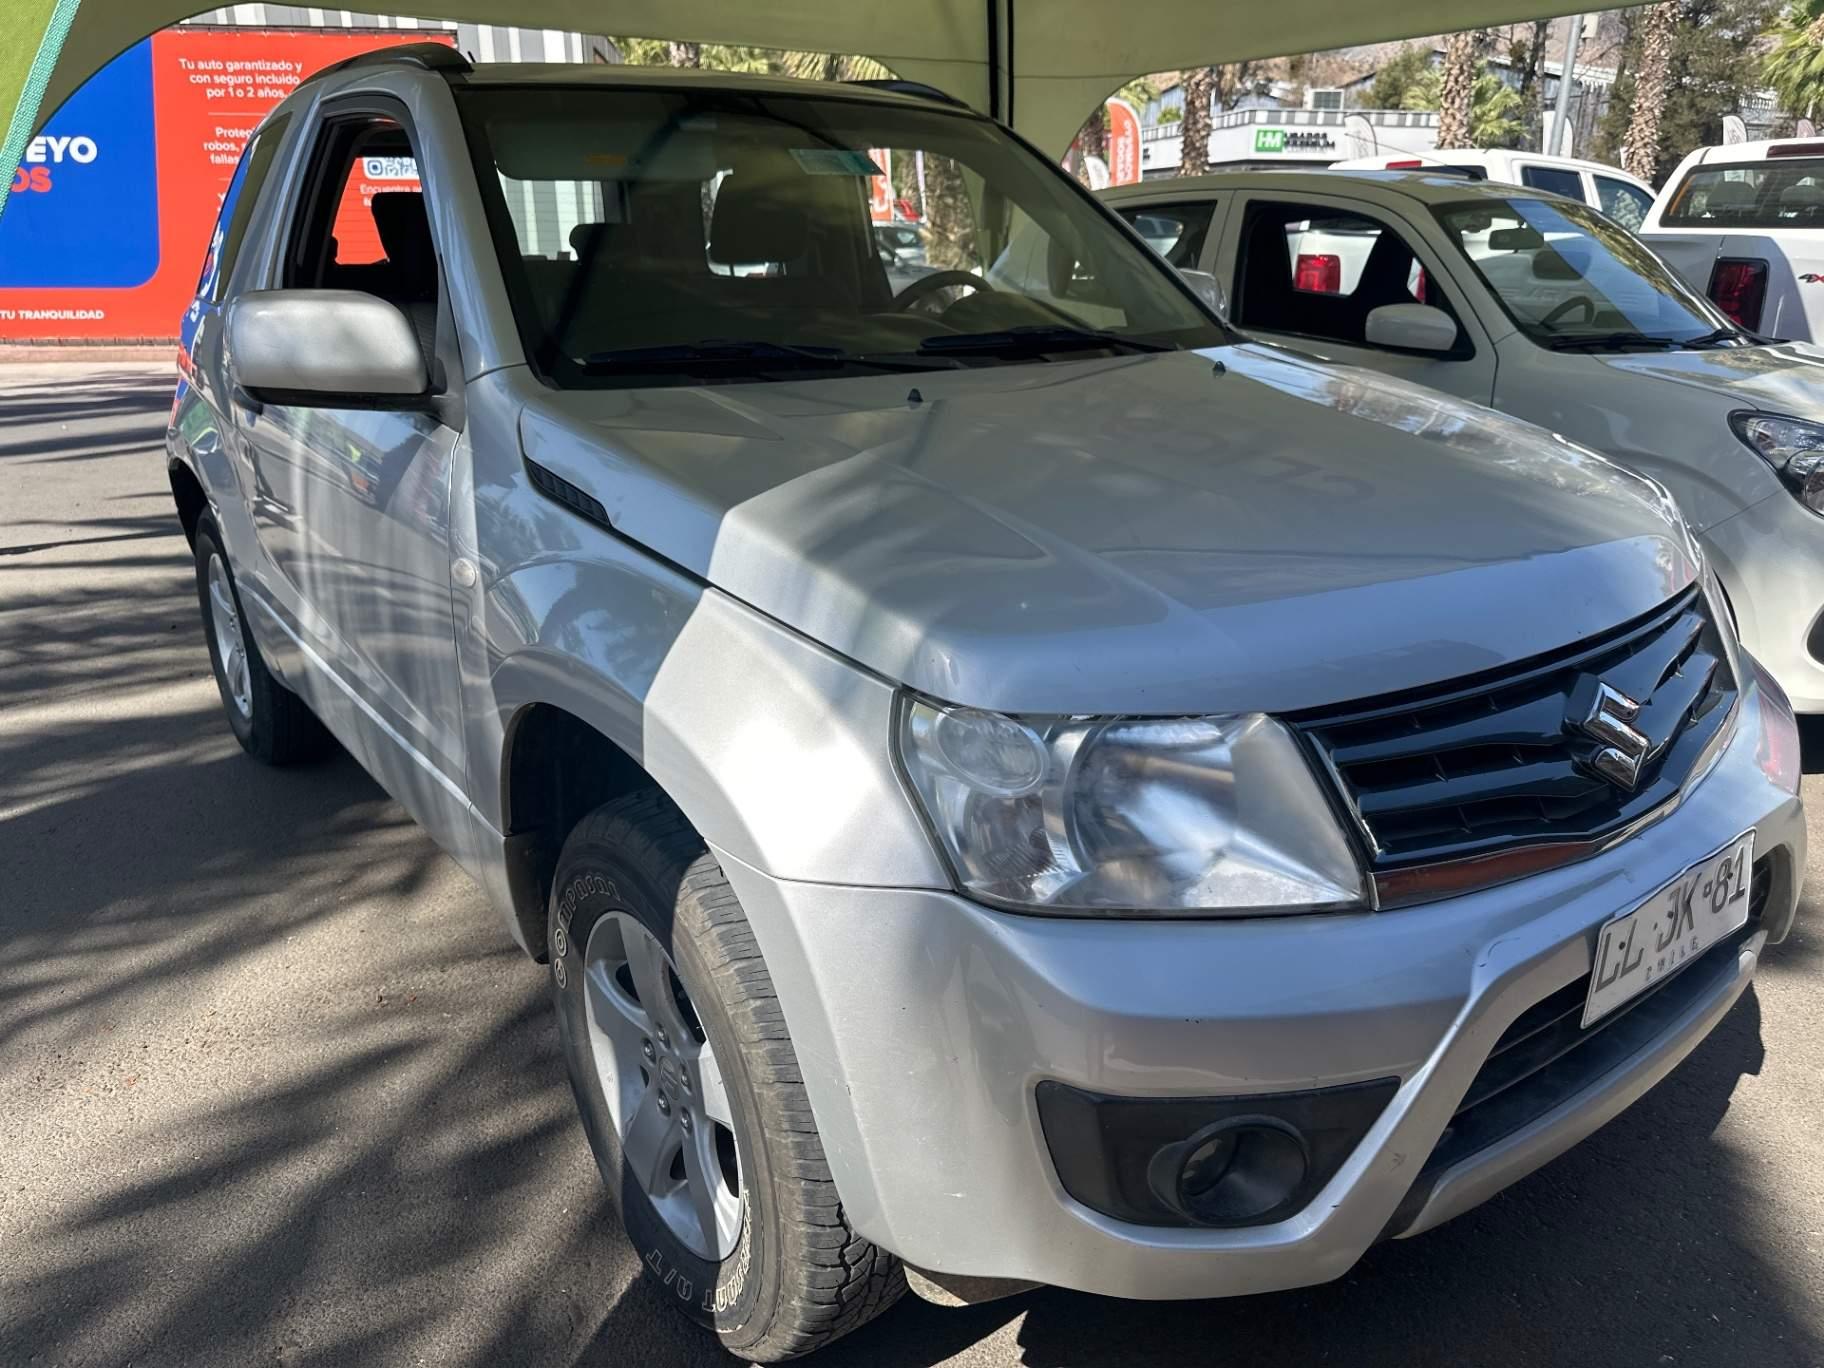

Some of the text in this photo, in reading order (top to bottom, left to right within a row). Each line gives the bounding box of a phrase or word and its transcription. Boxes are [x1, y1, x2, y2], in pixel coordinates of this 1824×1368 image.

[178, 58, 303, 73] Tu auto garantizado y
[189, 73, 301, 86] con seguro incluido
[206, 88, 225, 99] por
[236, 89, 244, 98] o
[247, 87, 255, 98] 2
[18, 310, 104, 320] TRANQUILIDAD
